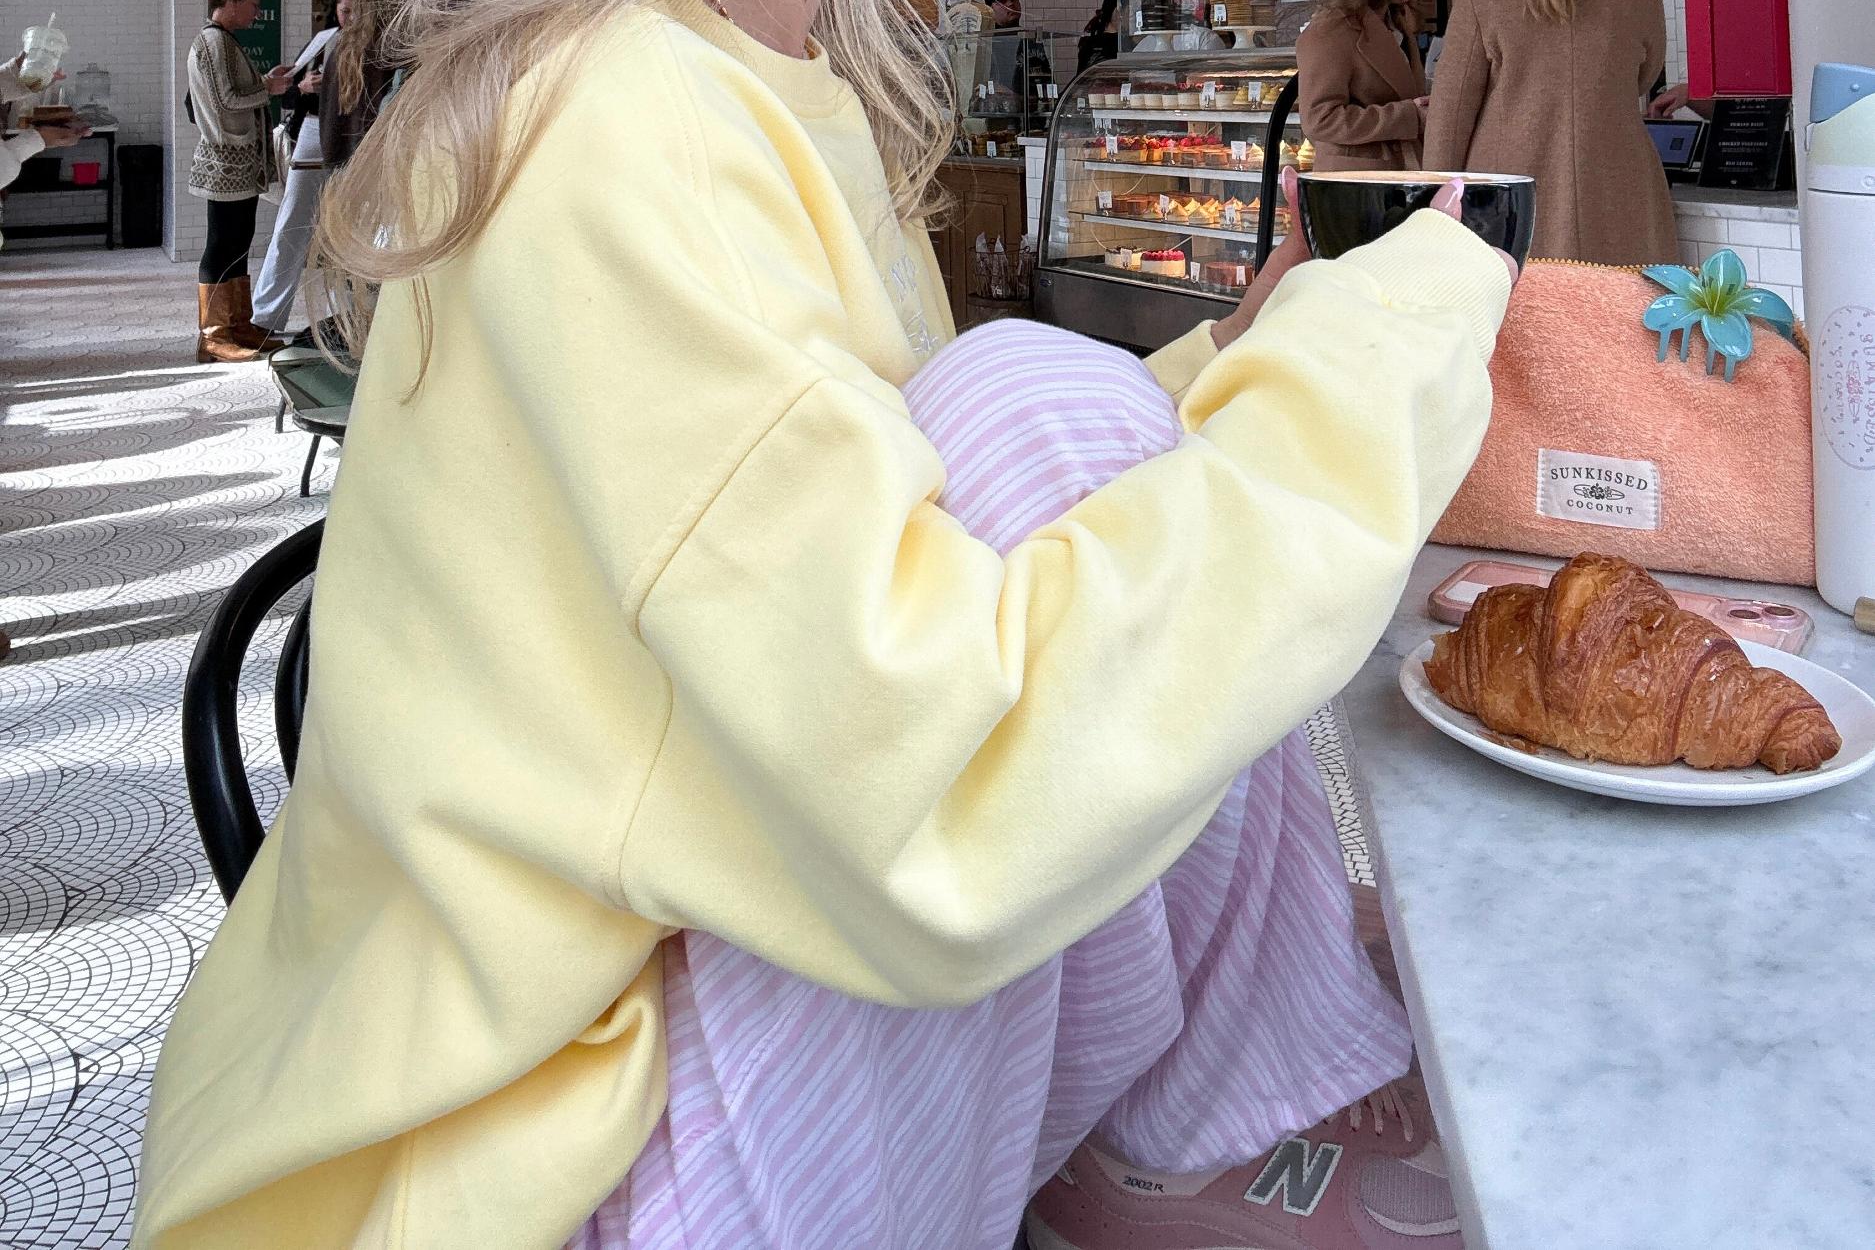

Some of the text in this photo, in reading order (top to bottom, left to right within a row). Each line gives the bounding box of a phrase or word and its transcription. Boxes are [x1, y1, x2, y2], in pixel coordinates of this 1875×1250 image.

[1550, 467, 1649, 492] SUNKISSED
[1566, 499, 1634, 515] COCONUT
[1243, 1137, 1344, 1217] N
